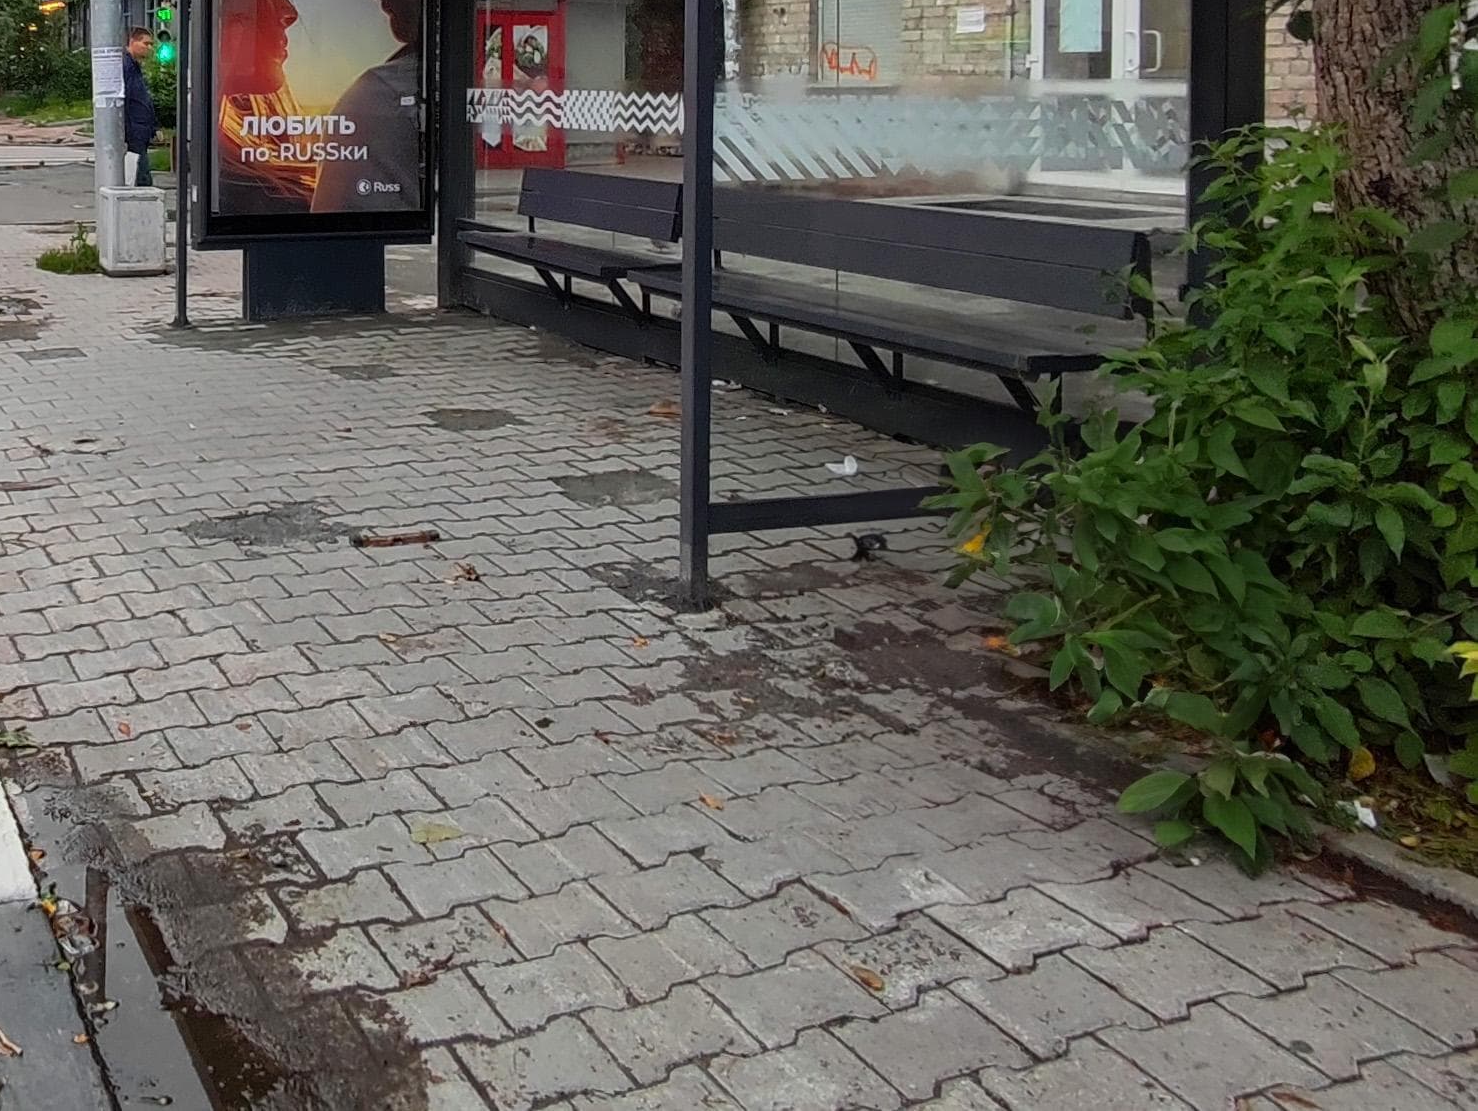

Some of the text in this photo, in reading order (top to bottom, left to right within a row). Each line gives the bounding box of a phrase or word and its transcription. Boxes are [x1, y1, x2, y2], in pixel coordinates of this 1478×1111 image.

[240, 115, 356, 136] ЛЮБИТЬ
[241, 142, 368, 162] по-RUSSки
[373, 181, 401, 193] Russ
